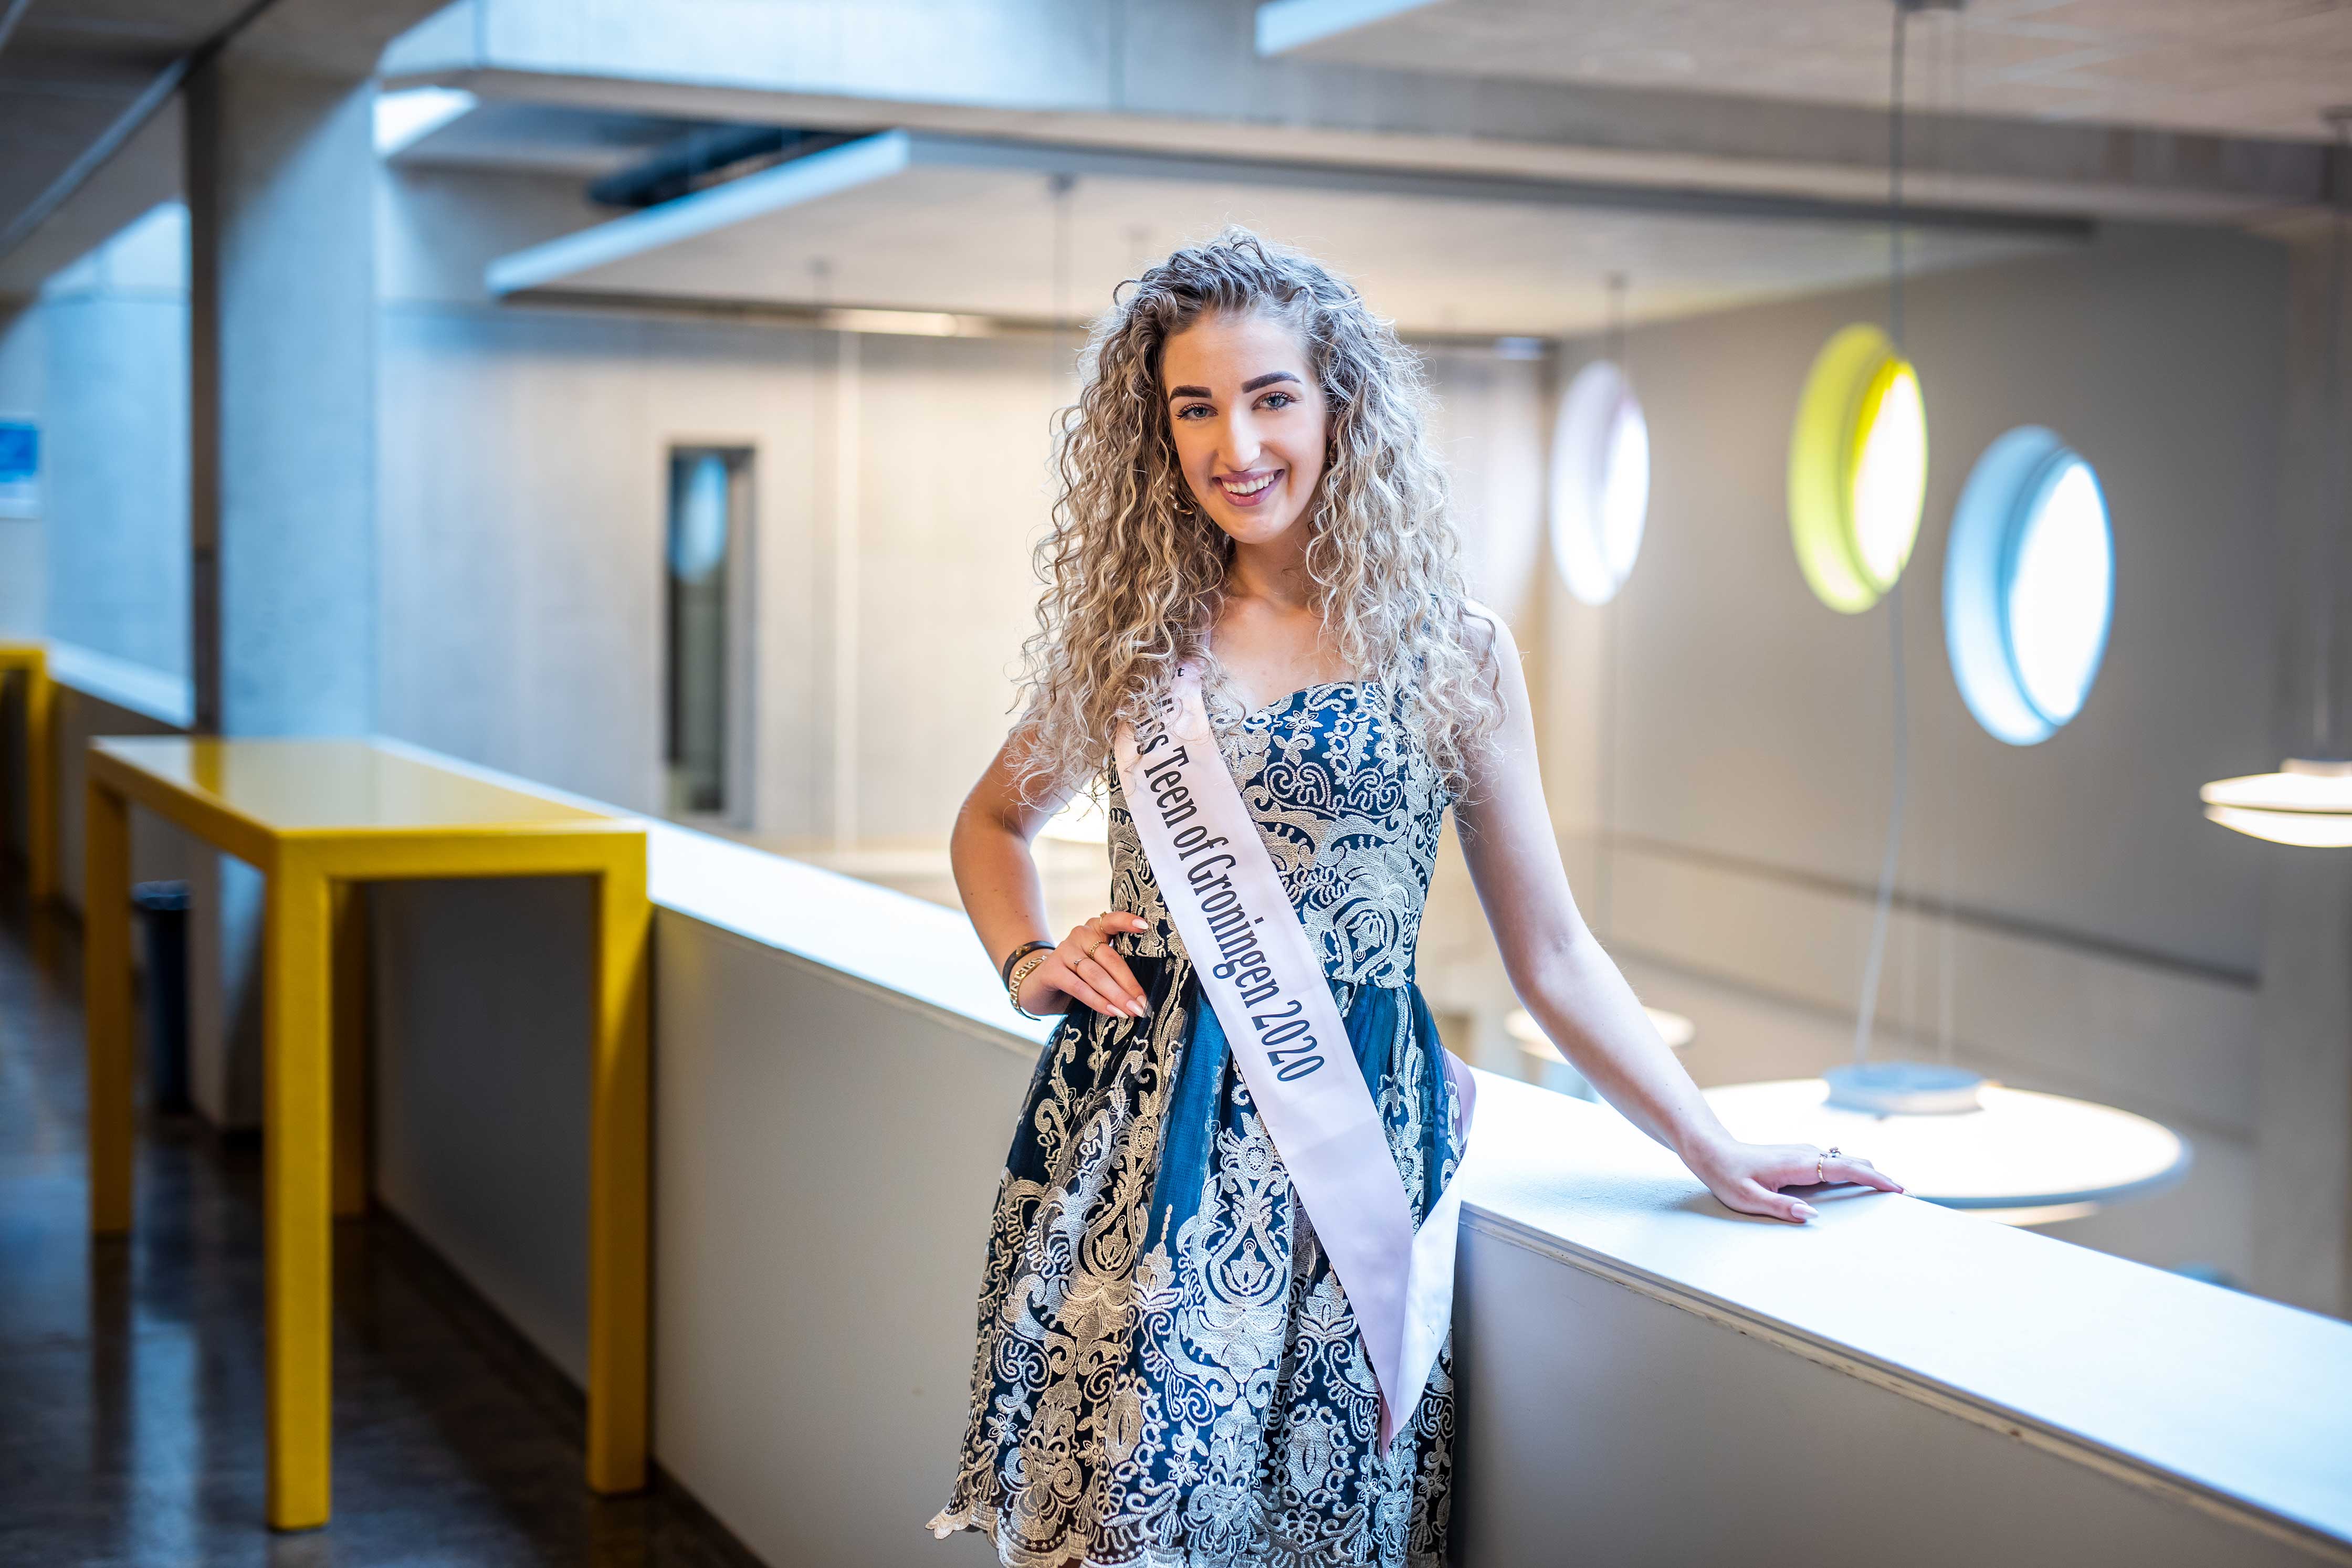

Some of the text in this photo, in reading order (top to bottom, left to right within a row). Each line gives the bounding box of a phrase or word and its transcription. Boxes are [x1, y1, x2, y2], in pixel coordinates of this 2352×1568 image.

[1144, 745, 1197, 829] Teen
[1173, 825, 1229, 861] of
[1187, 854, 1279, 1009] Groningen
[1251, 999, 1325, 1082] 2020
